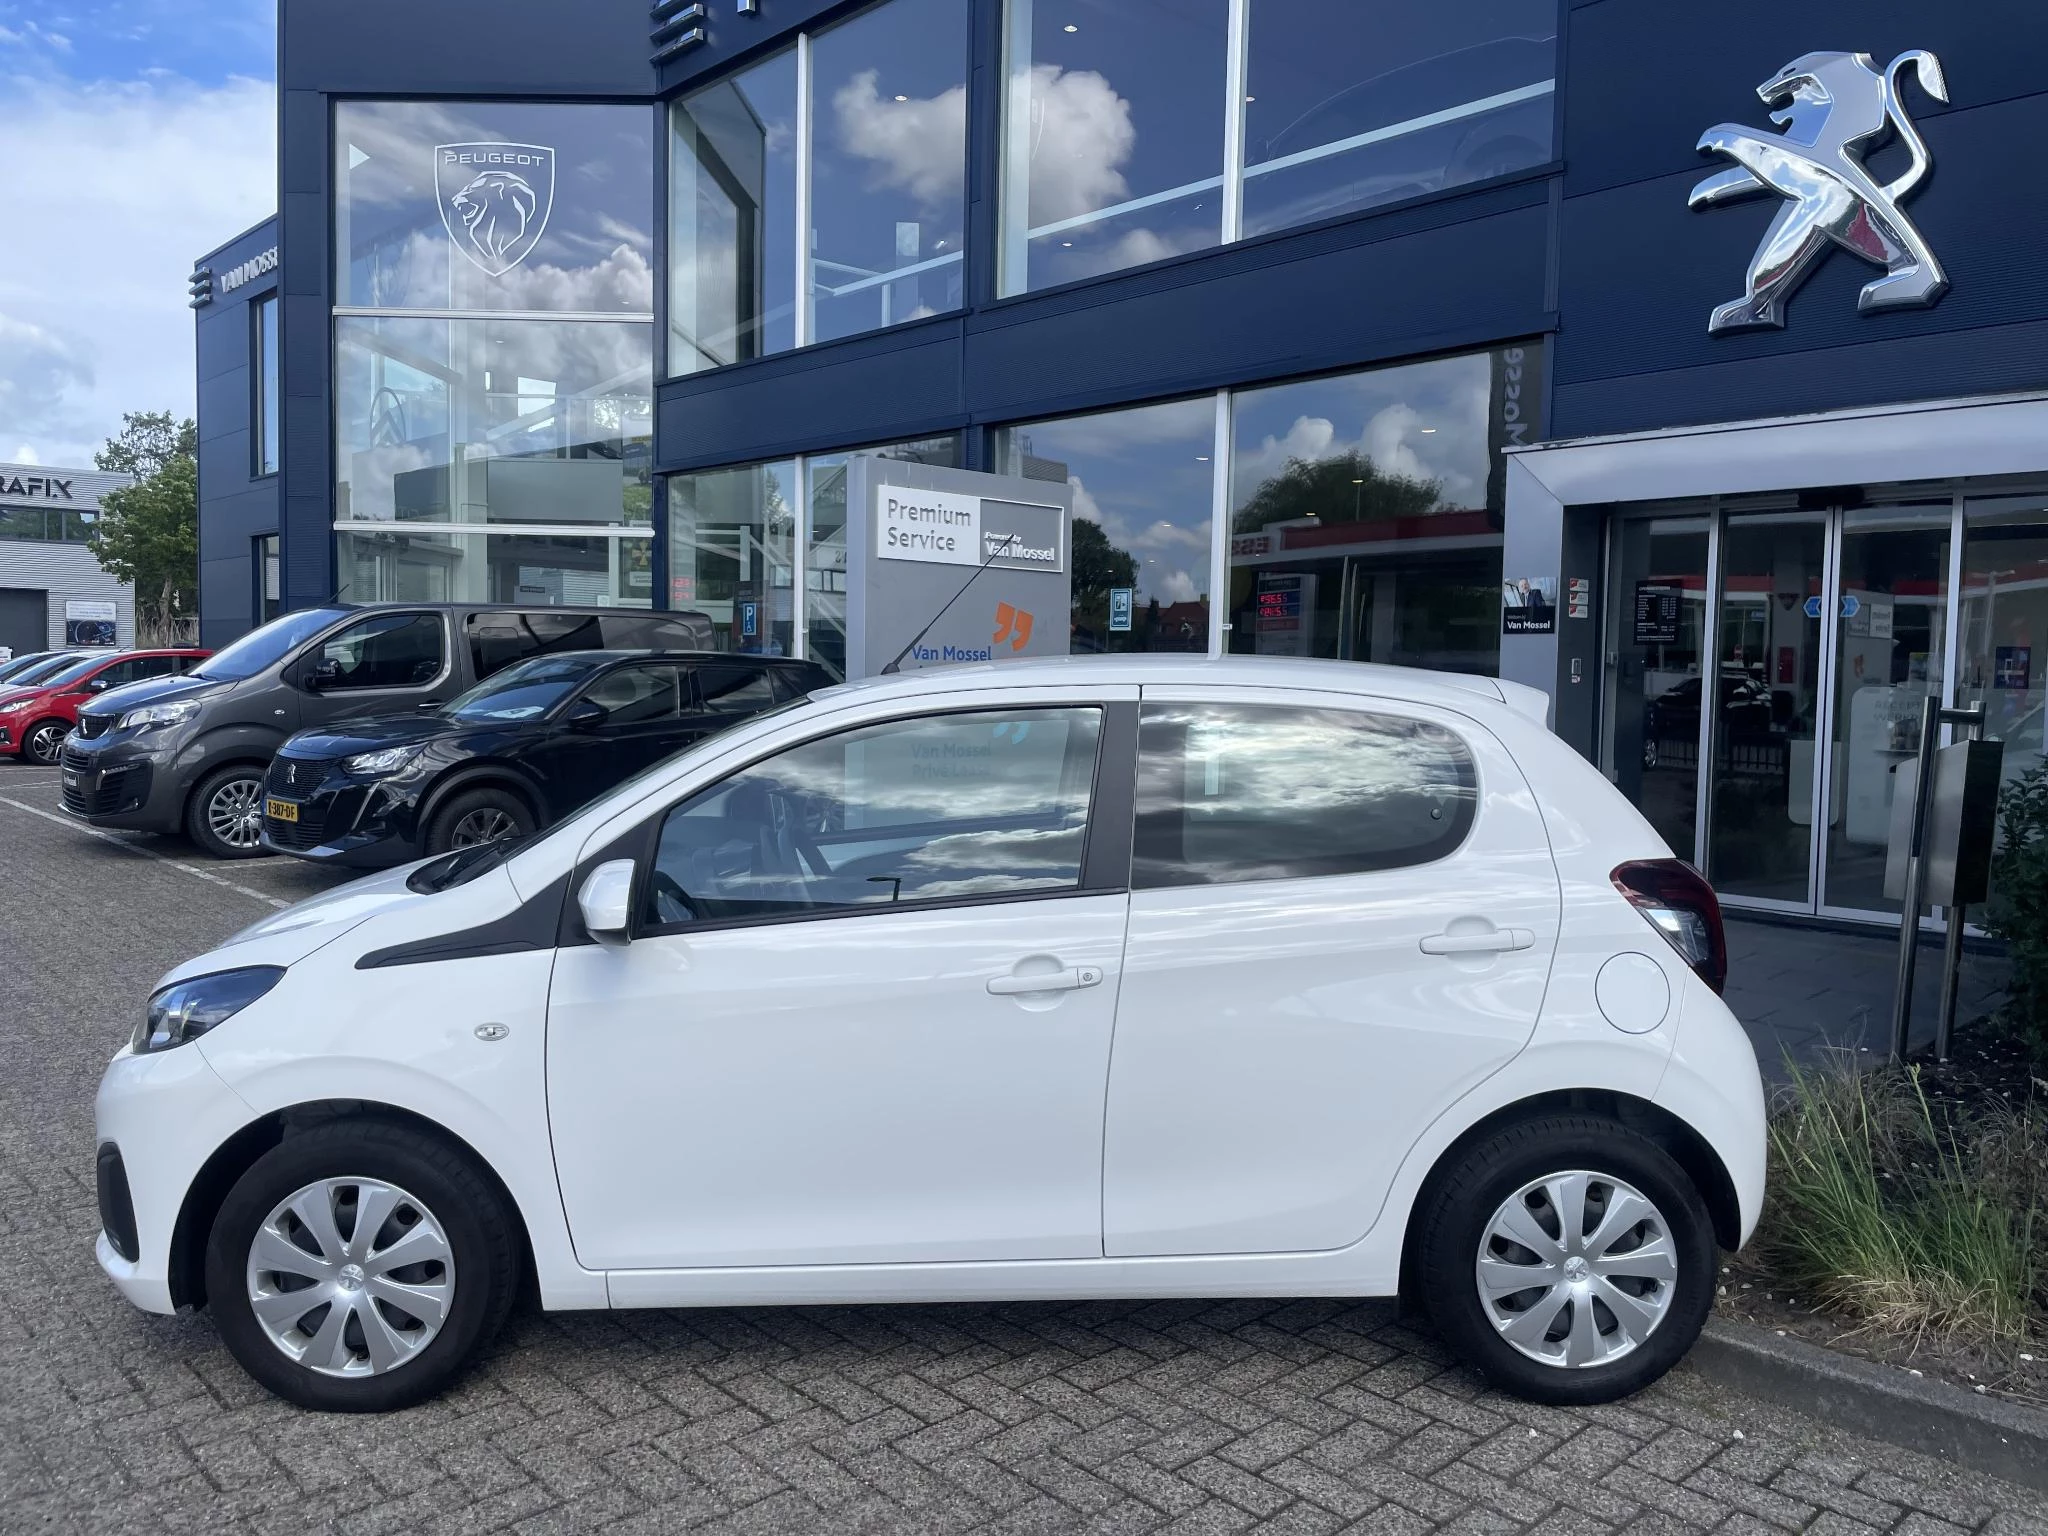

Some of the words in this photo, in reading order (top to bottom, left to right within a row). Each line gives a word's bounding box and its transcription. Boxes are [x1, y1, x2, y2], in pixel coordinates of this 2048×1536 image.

[444, 152, 545, 167] PEUGEOT
[221, 265, 244, 293] VAN
[887, 498, 971, 527] Premium
[887, 526, 956, 551] Service
[985, 541, 1009, 558] Van
[1012, 543, 1055, 561] Mossel
[1507, 620, 1522, 629] Van
[1523, 620, 1551, 630] Mossel
[912, 645, 939, 661] Van
[943, 645, 992, 661] Mossel
[911, 743, 939, 759] Van
[943, 740, 992, 758] Mossel
